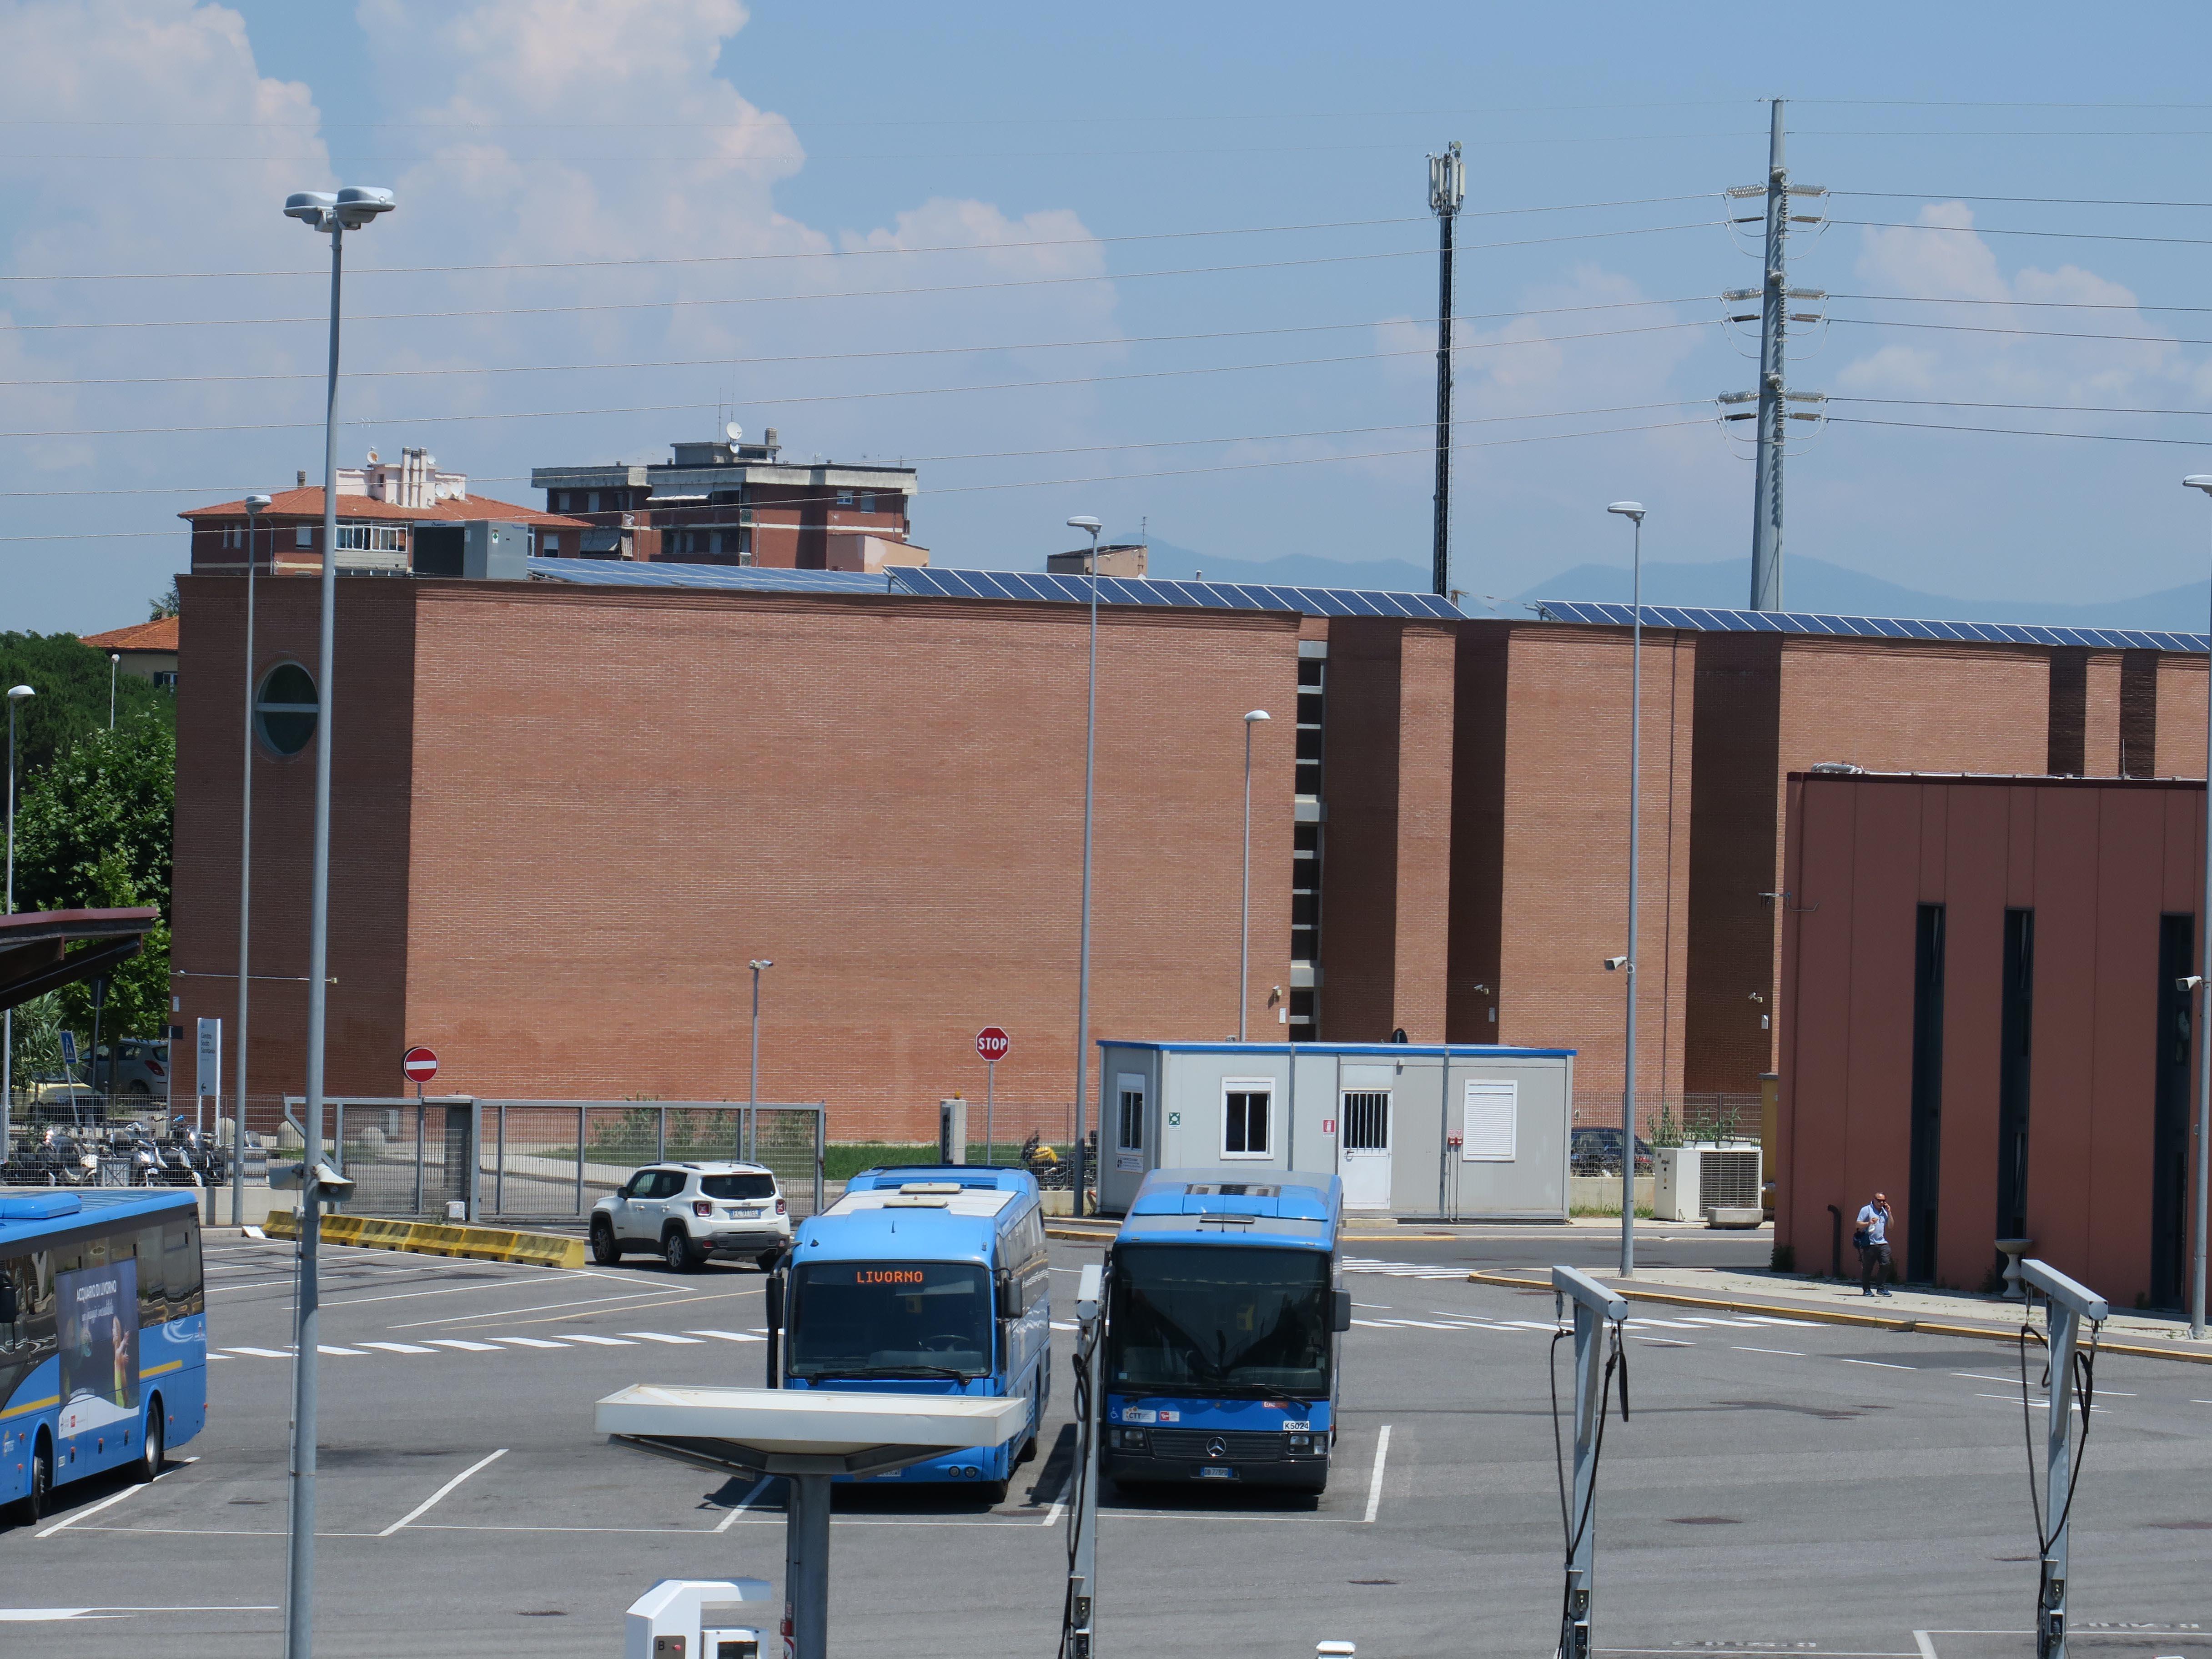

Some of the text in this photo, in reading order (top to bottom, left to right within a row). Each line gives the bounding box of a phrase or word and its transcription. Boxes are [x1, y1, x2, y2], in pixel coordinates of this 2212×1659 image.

[978, 1037, 1007, 1050] STOP
[857, 1271, 924, 1283] LIVORNO
[658, 1640, 664, 1650] B
